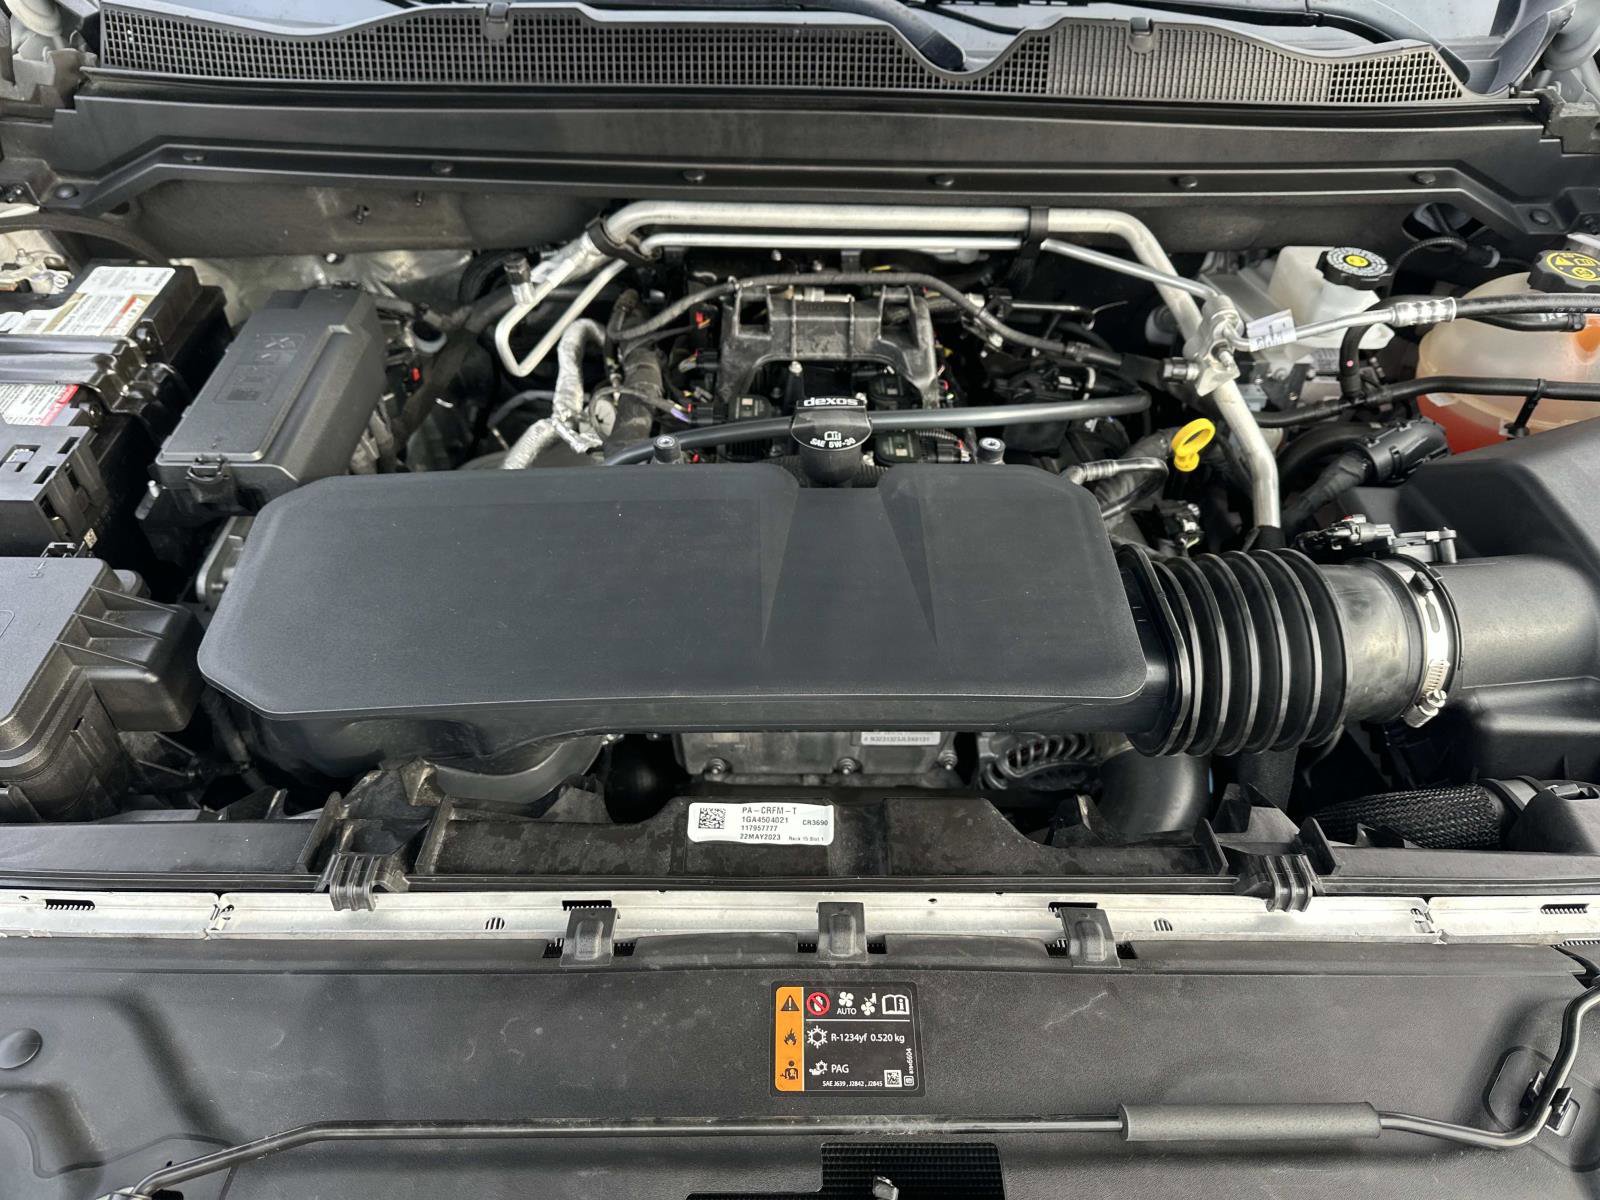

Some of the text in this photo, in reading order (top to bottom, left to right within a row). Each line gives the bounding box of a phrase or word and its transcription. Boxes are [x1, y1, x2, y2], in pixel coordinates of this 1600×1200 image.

[803, 397, 858, 406] dexos
[810, 437, 857, 448] SAE 5W-30
[742, 816, 789, 824] 1GA4504021
[740, 833, 781, 841] 22MAY2023
[836, 1007, 857, 1015] AUTO
[831, 1032, 905, 1044] R-1234yf 0.520 kg
[831, 1064, 849, 1074] PAG
